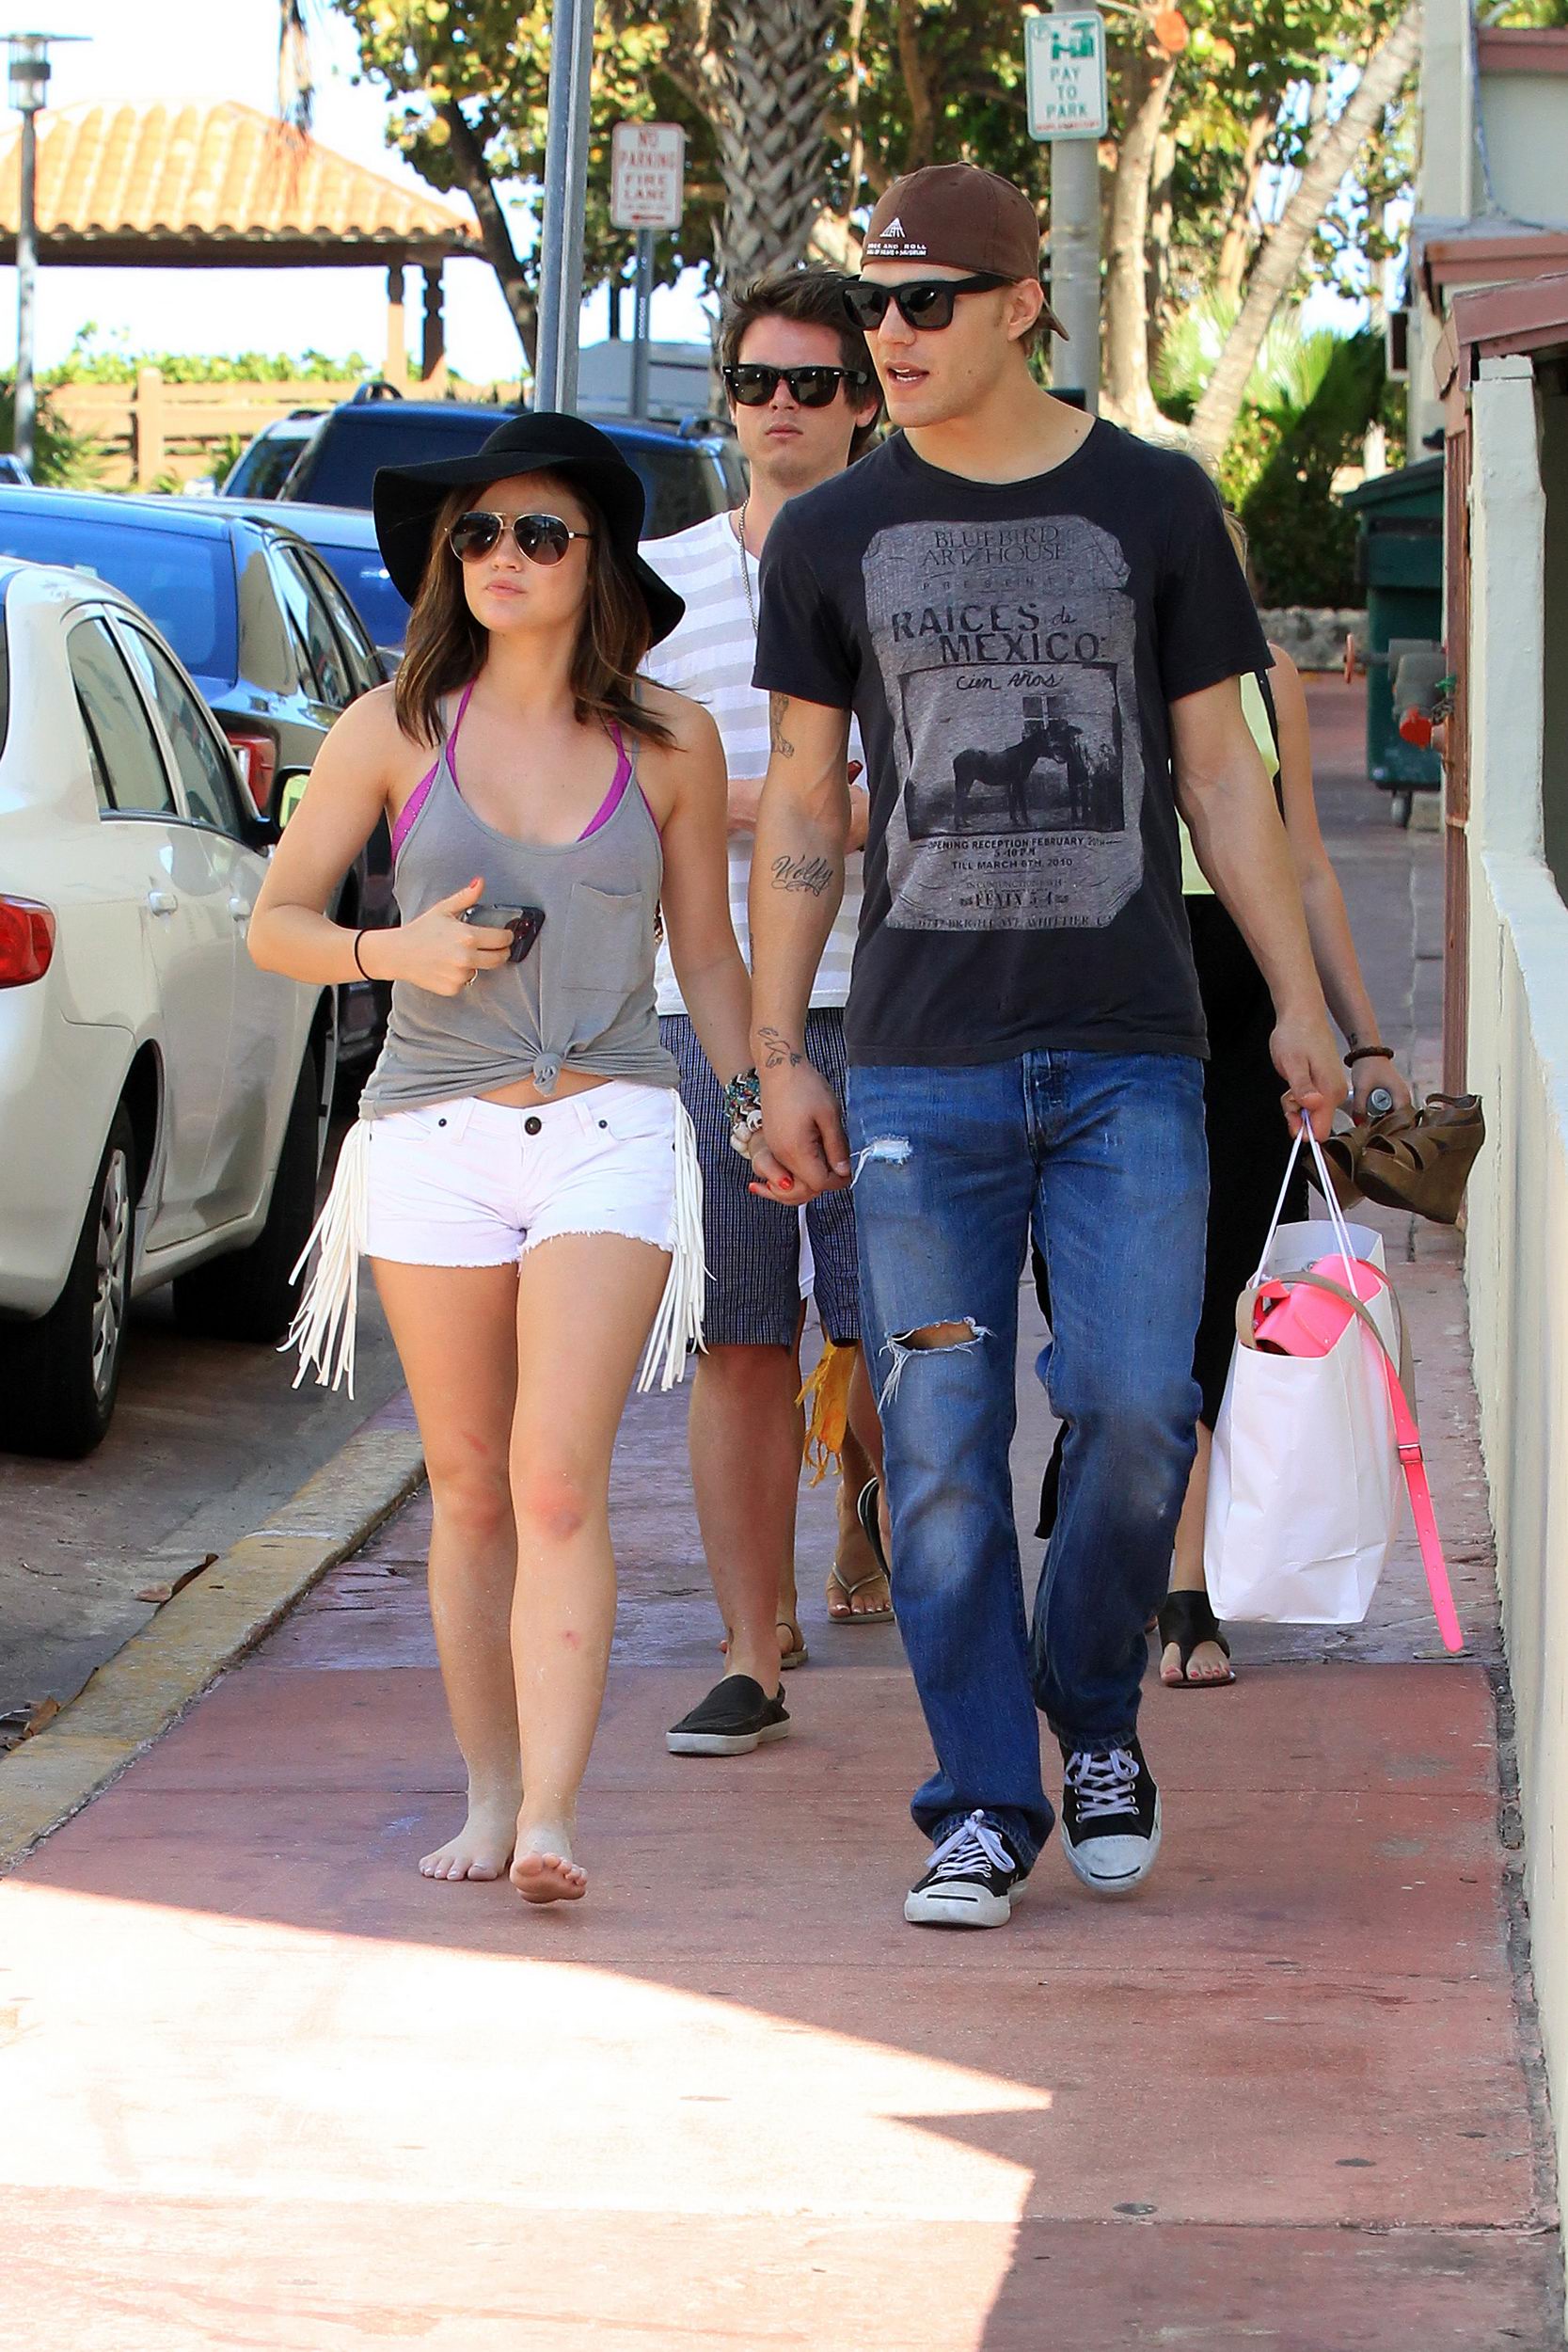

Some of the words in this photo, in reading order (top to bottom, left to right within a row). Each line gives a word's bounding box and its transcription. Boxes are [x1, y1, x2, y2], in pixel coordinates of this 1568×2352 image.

[1051, 67, 1079, 81] PAY
[1058, 85, 1077, 99] TO
[639, 131, 657, 147] NO
[621, 151, 676, 167] PARKING
[625, 174, 667, 185] FIRE
[624, 189, 667, 199] LANE
[986, 543, 1063, 564] HOUSE
[892, 604, 1039, 643] RAICES
[972, 838, 1029, 850] RECEPTION
[1032, 836, 1085, 847] FEBRUARY
[952, 860, 974, 870] TILL
[978, 860, 1018, 869] MARCH
[1047, 858, 1073, 866] 2010
